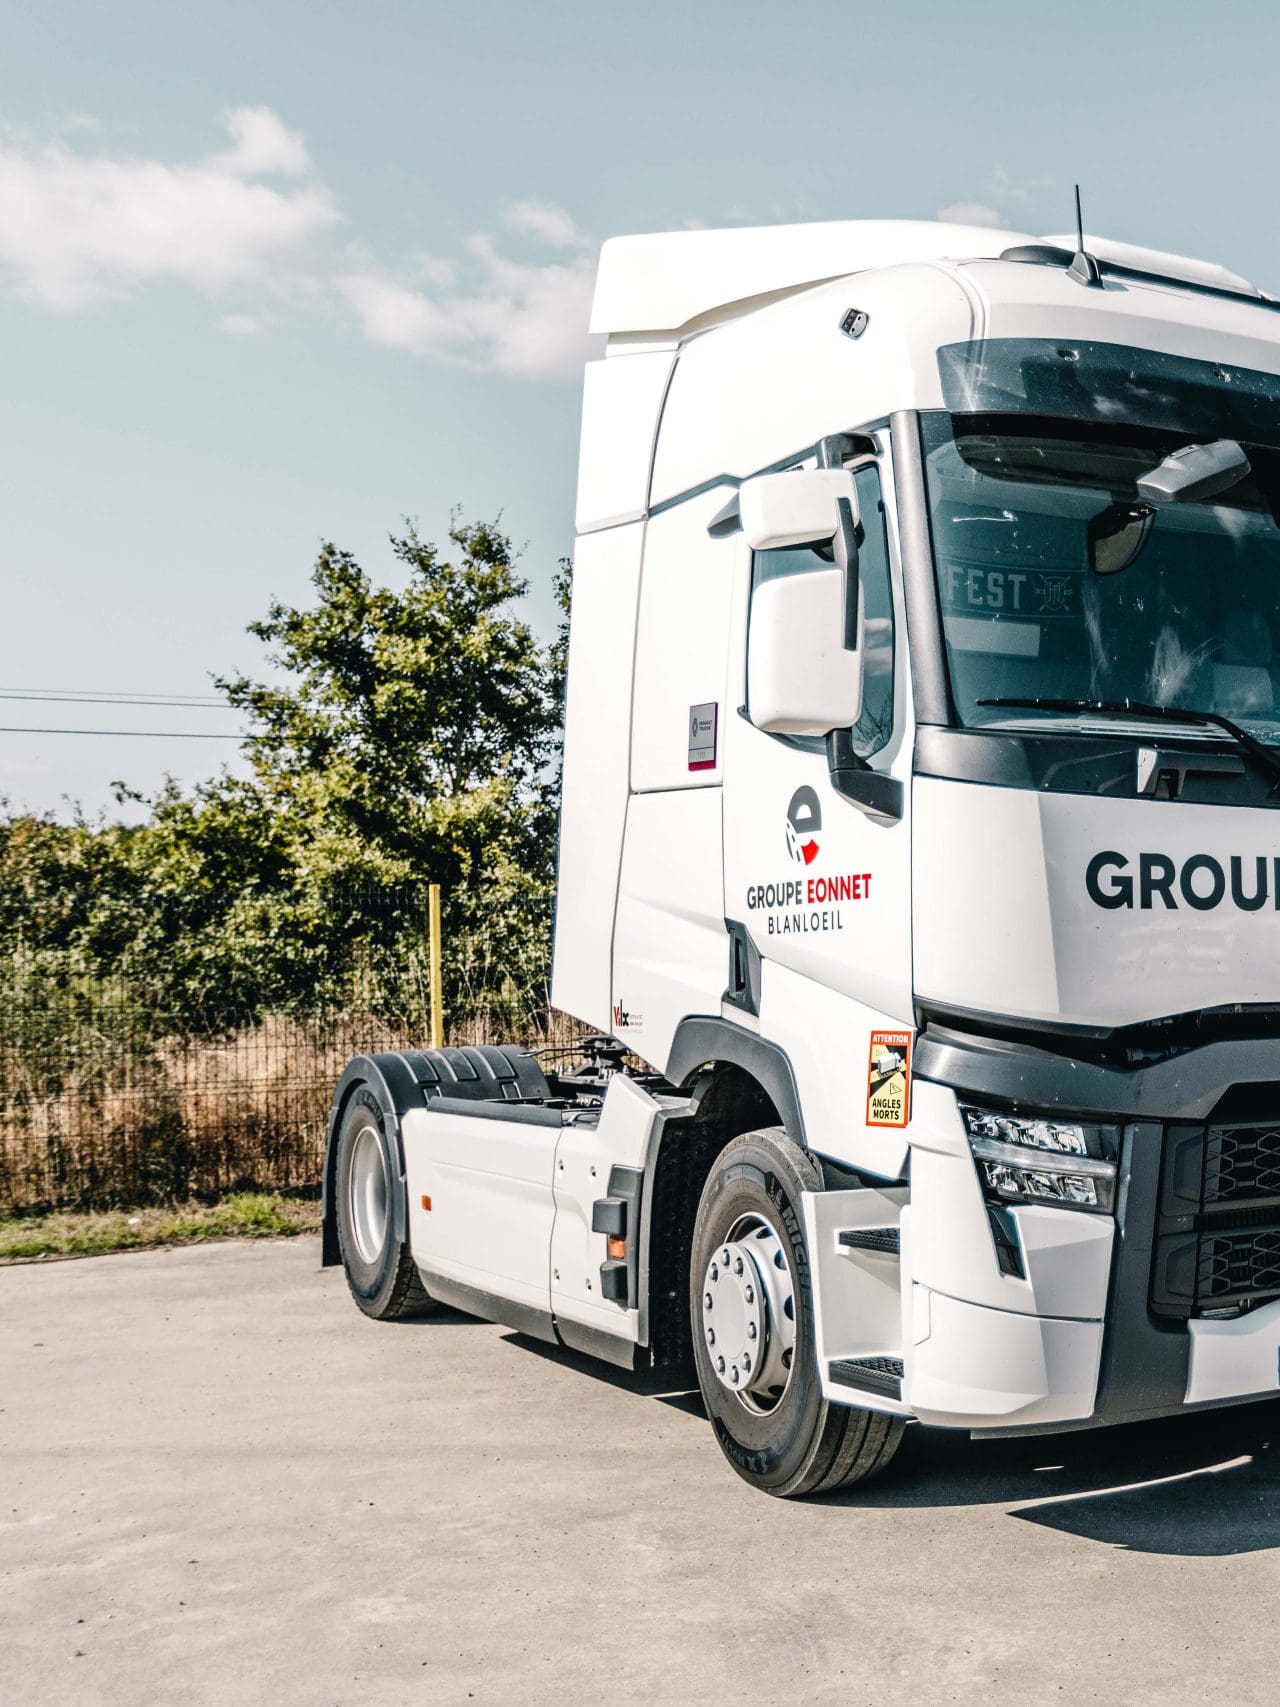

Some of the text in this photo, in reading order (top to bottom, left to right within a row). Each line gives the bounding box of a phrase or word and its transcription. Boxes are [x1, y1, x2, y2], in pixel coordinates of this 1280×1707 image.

[747, 873, 872, 910] GROUPE EONNET
[768, 910, 843, 934] BLANLOEIL
[873, 1034, 908, 1043] ATTENTION
[872, 1098, 901, 1109] ANGLES
[873, 1109, 899, 1120] MORTS
